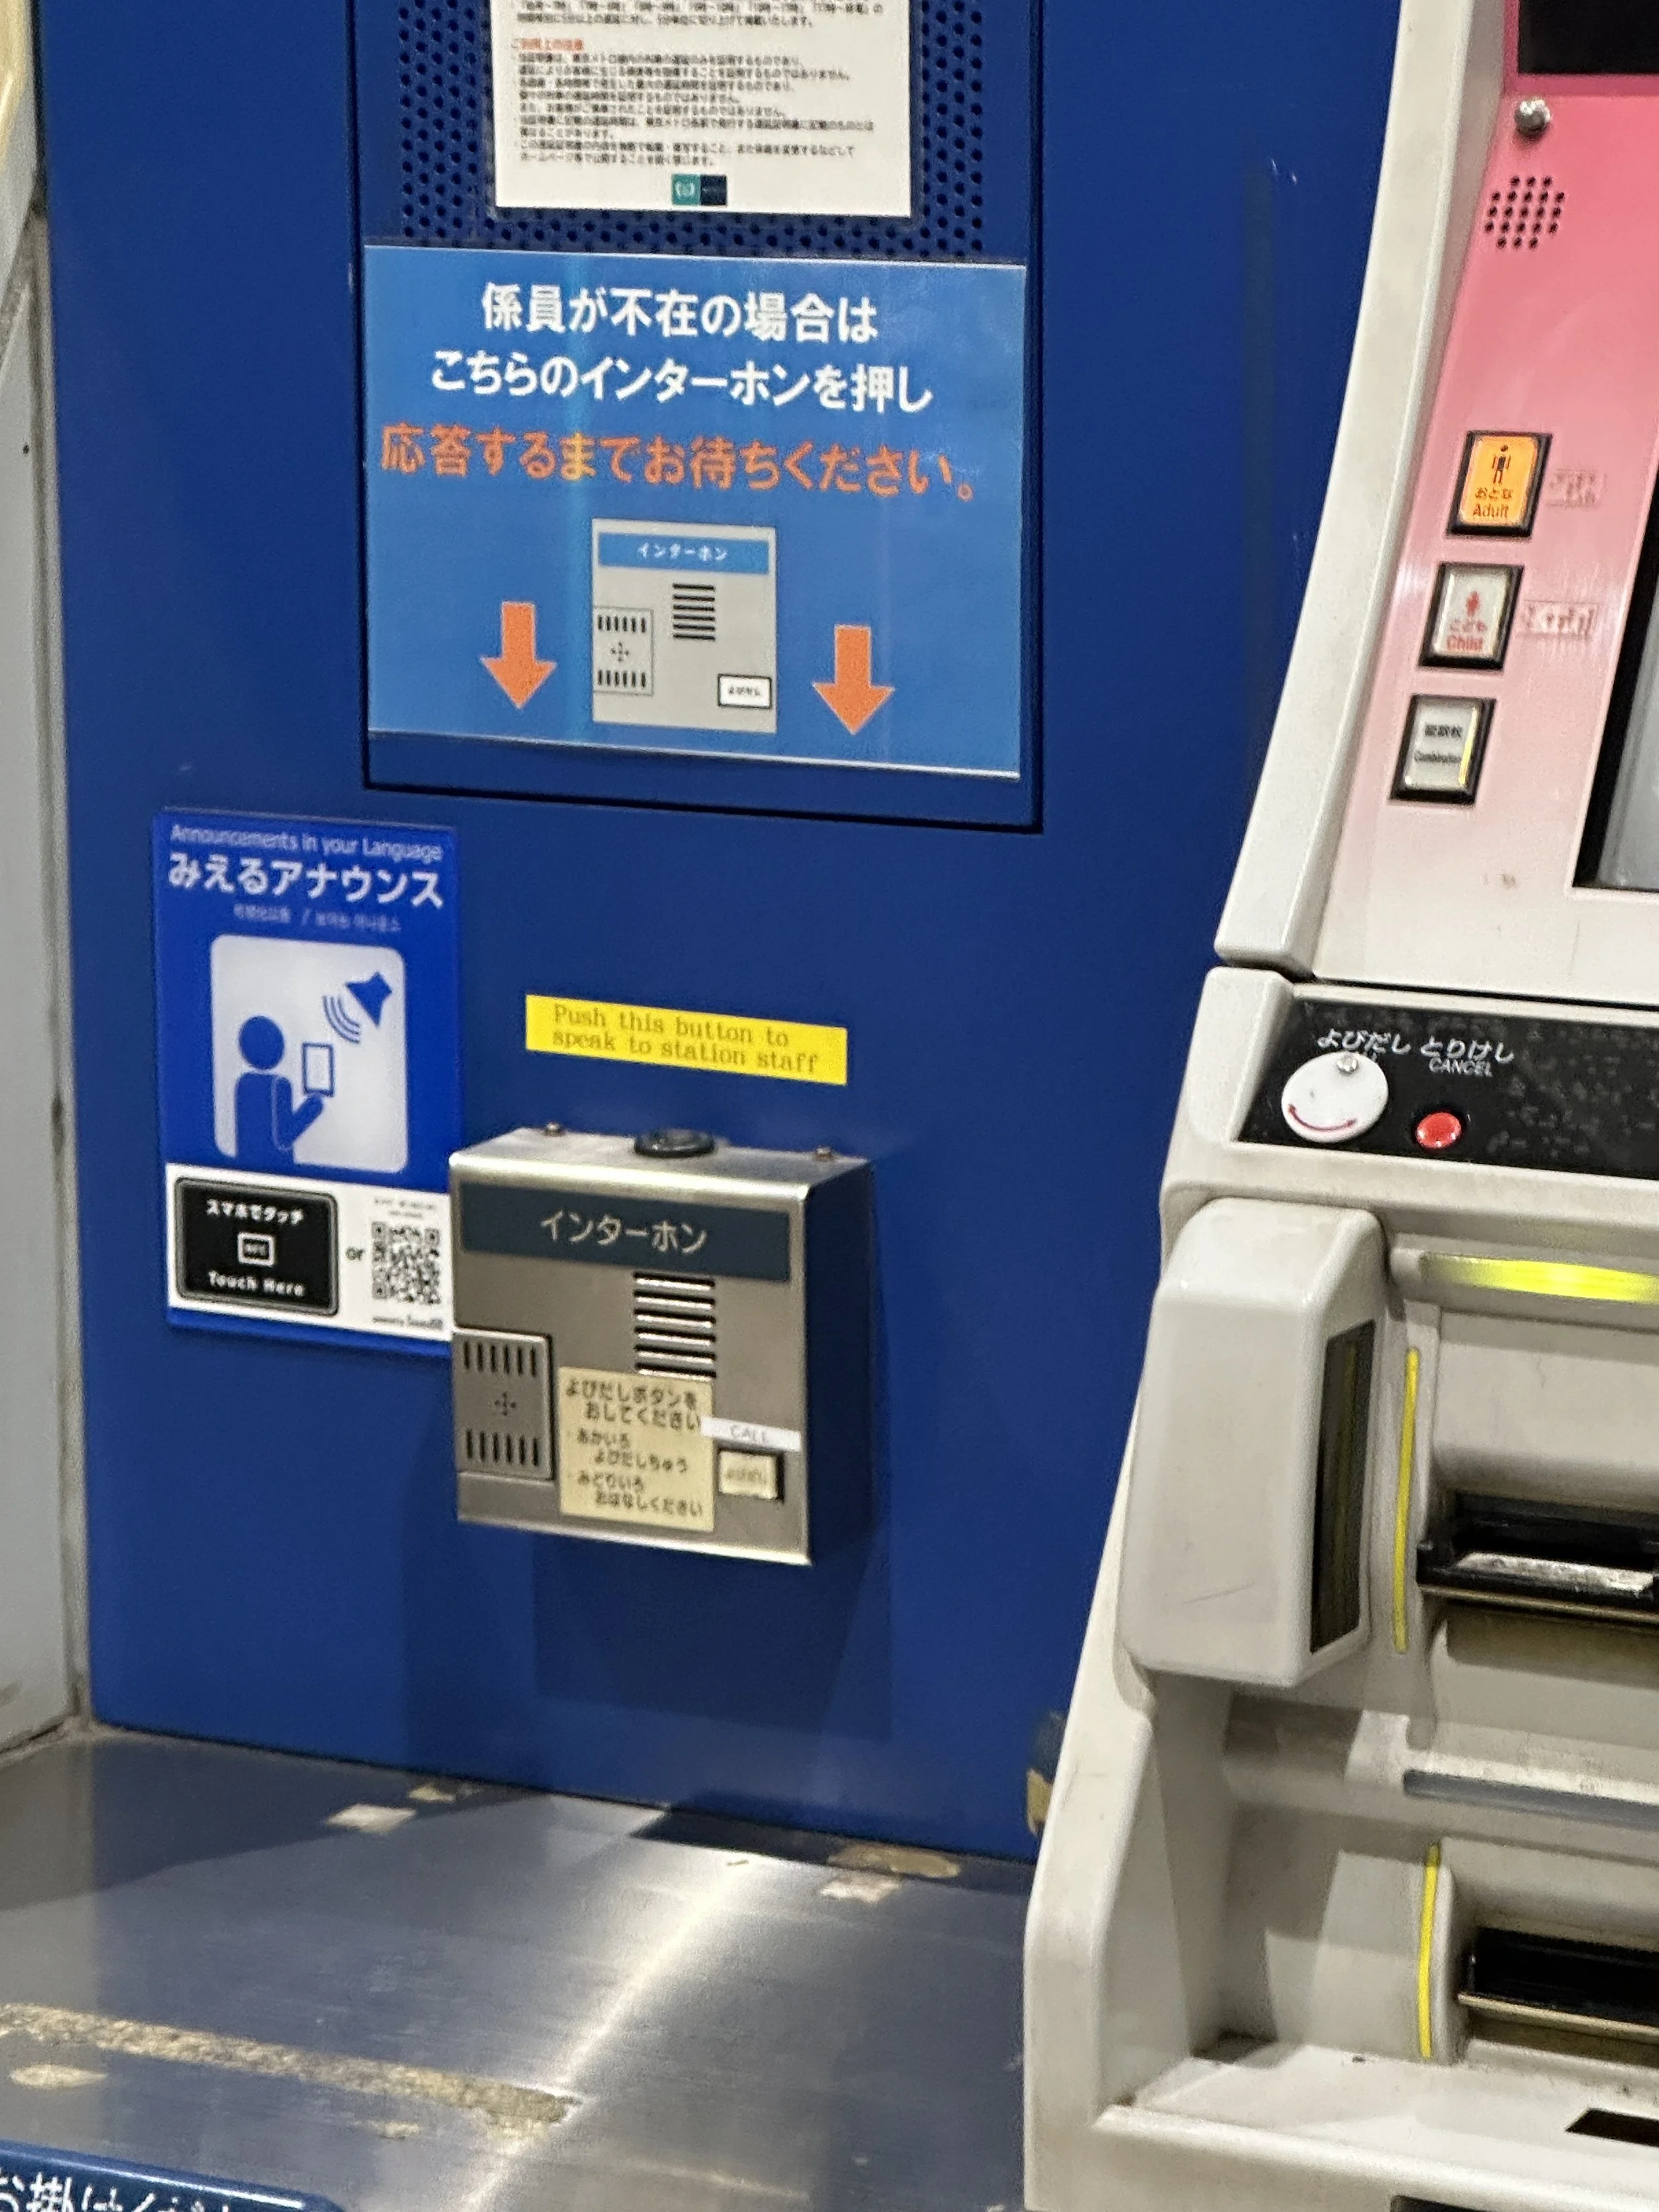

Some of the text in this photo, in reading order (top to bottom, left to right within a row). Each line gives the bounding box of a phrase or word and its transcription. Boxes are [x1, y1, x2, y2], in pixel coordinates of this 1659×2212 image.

[482, 282, 879, 343] 係員が不在の場合は
[431, 349, 932, 413] こちらのインターホンを押し
[380, 421, 974, 502] 応答するまでお待ちください。
[1473, 503, 1509, 518] Adult
[637, 542, 727, 561] インターホン
[1447, 634, 1483, 652] Child
[171, 824, 299, 851] Announcements
[321, 838, 358, 856] your
[362, 838, 443, 863] Language
[168, 851, 444, 909] みえるアナウンス
[552, 1003, 790, 1047] Push this button to
[551, 1028, 819, 1074] speak to station staff
[1317, 1029, 1411, 1055] よびだし
[1420, 1035, 1514, 1064] とりけし
[1429, 1057, 1492, 1078] CANCEL
[541, 1210, 707, 1254] インターホン
[345, 1246, 366, 1261] or
[208, 1270, 305, 1297] Touch Here
[565, 1378, 697, 1410] よびだしボタンを
[731, 1425, 768, 1442] CALL
